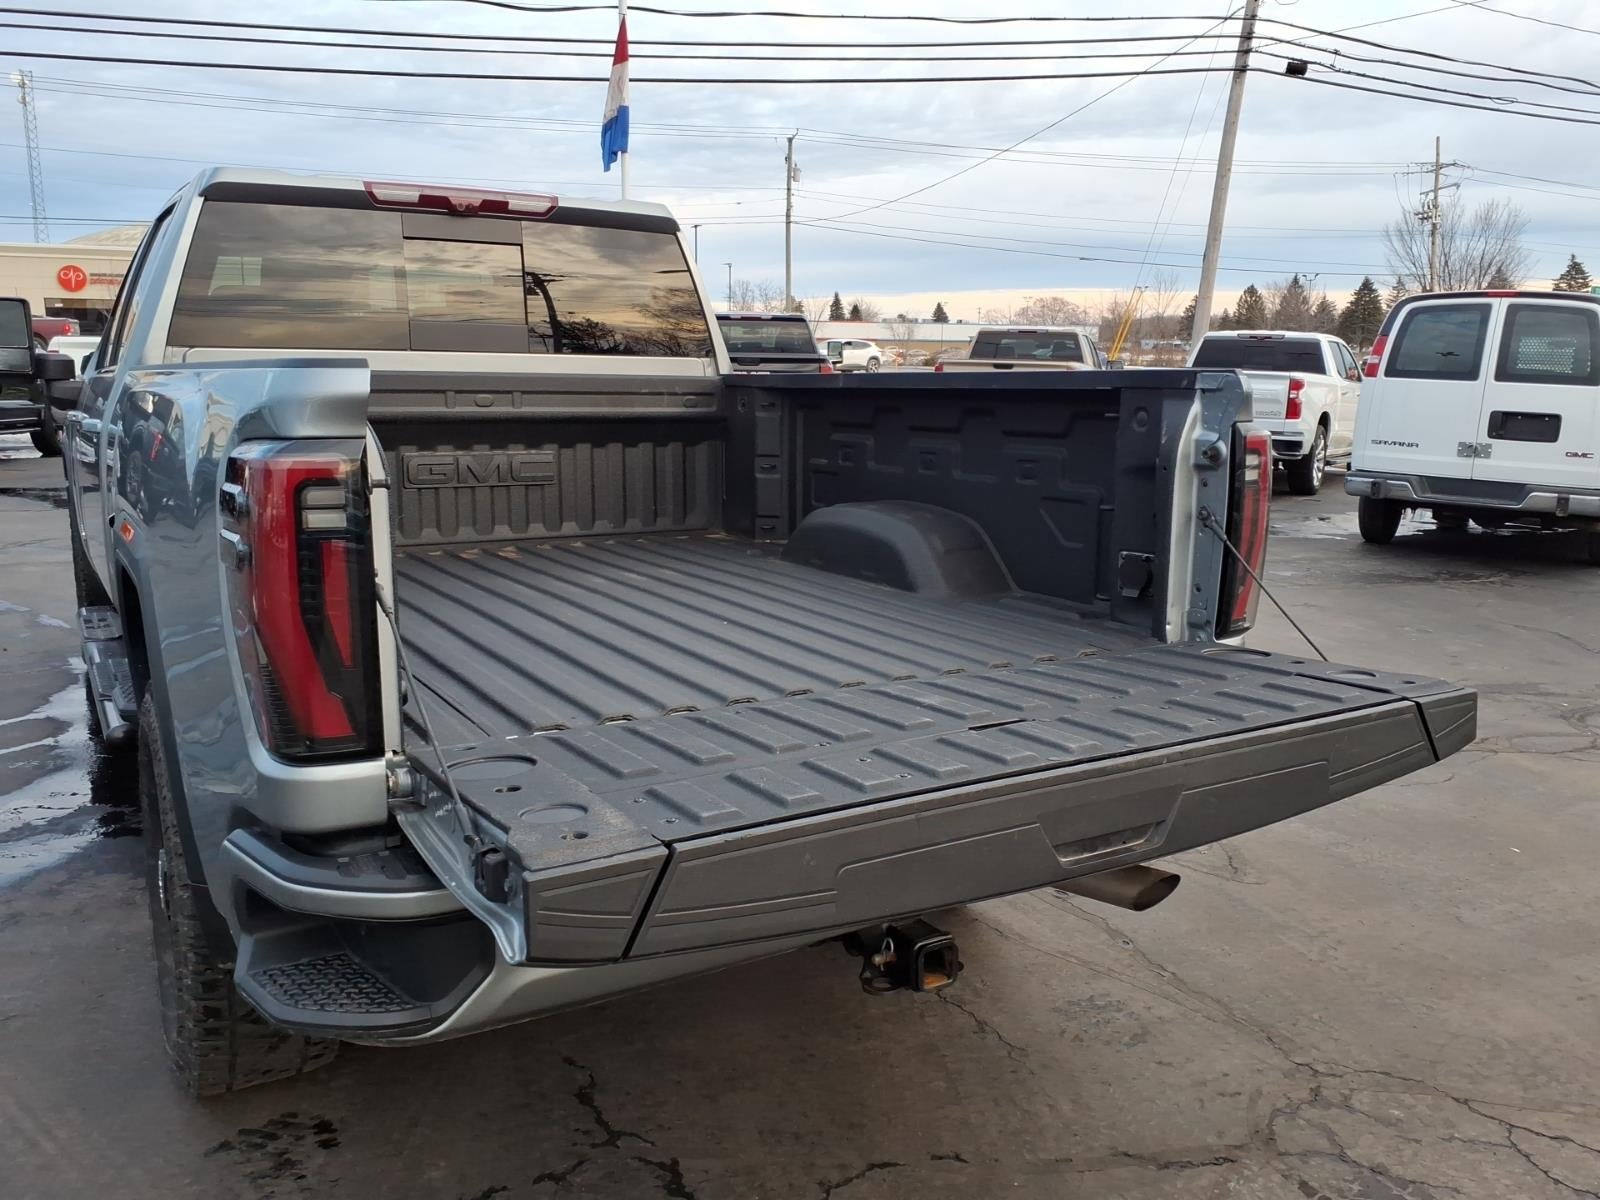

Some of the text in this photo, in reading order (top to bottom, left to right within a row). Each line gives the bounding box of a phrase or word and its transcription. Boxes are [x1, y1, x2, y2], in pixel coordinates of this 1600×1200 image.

[1371, 439, 1419, 448] SAVANA
[1565, 451, 1595, 459] GMC
[407, 453, 555, 485] GMC
